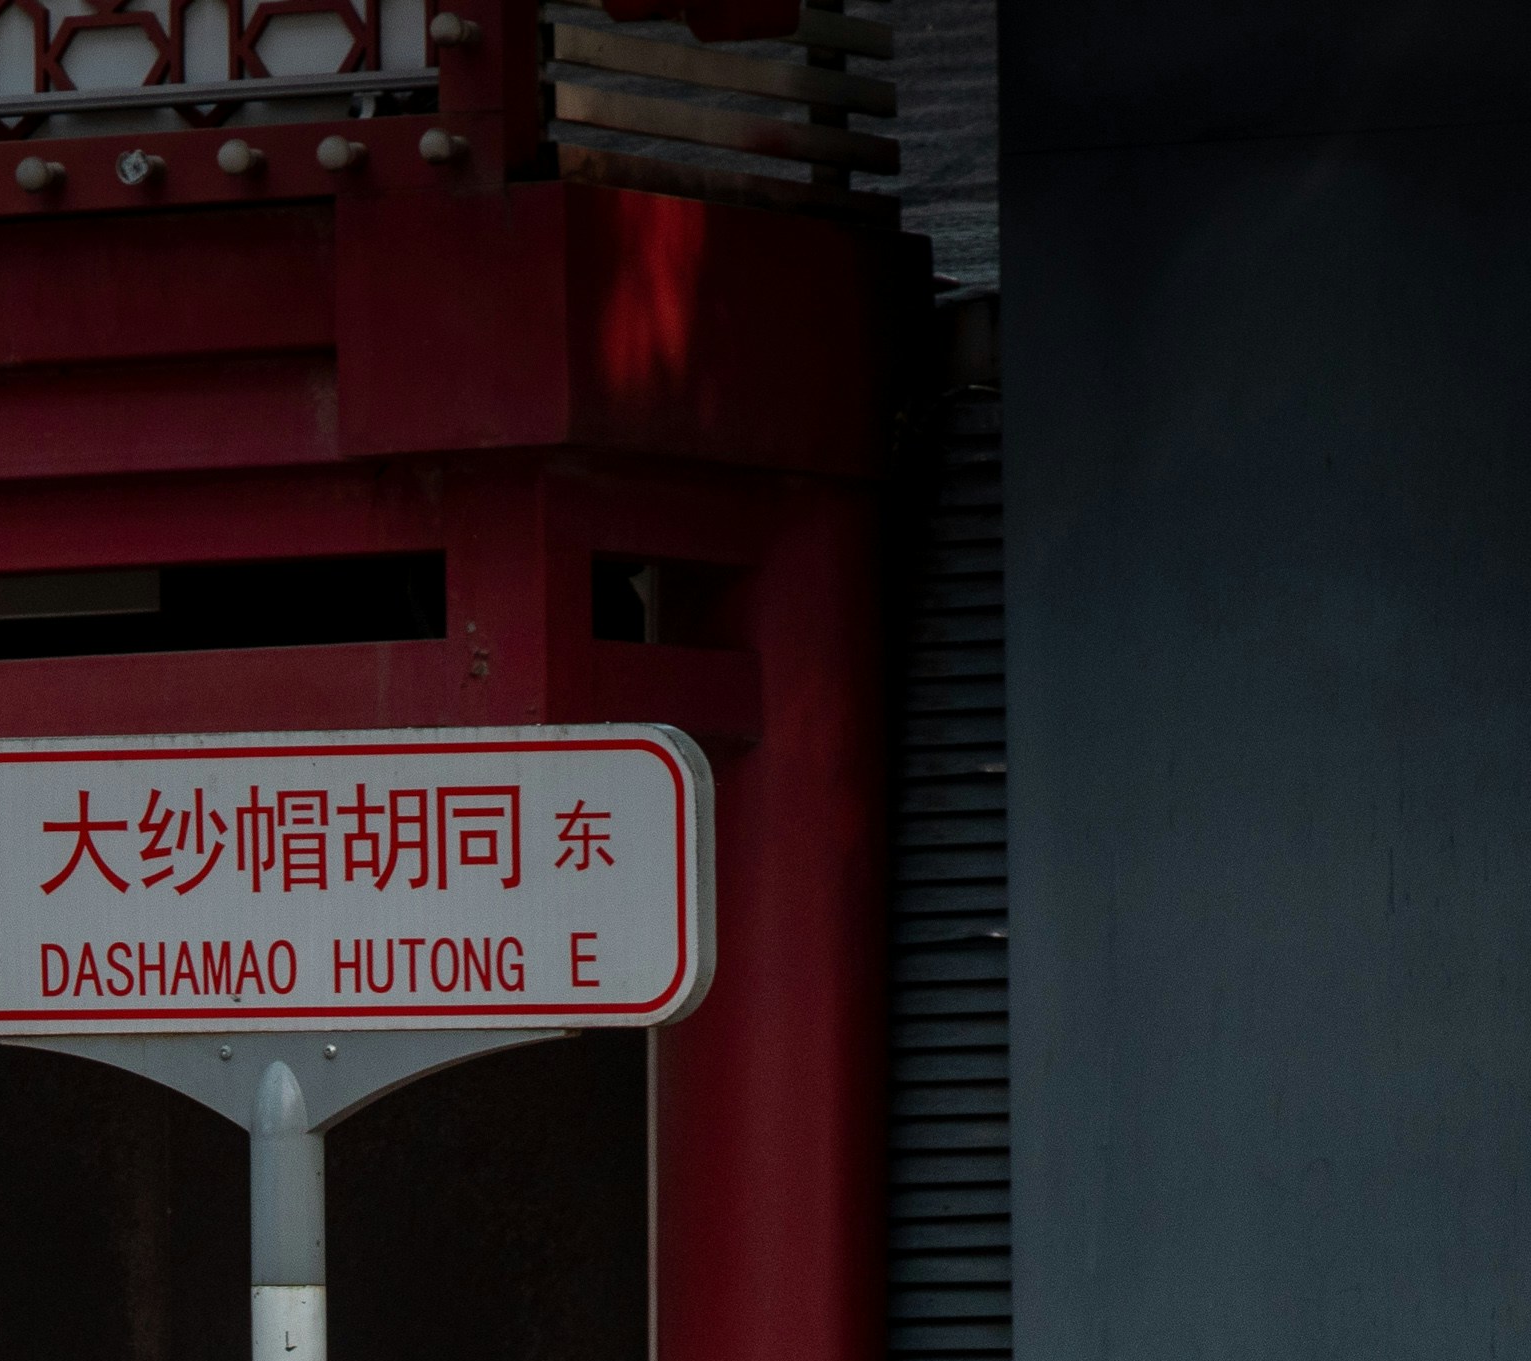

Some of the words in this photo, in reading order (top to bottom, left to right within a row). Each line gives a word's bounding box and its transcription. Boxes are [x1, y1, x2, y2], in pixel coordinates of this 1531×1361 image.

[39, 784, 523, 897] 大纱帽胡同
[554, 799, 617, 872] 东
[39, 938, 298, 999] DASHAMAO
[333, 936, 527, 994] HUTONG
[570, 931, 601, 989] E
